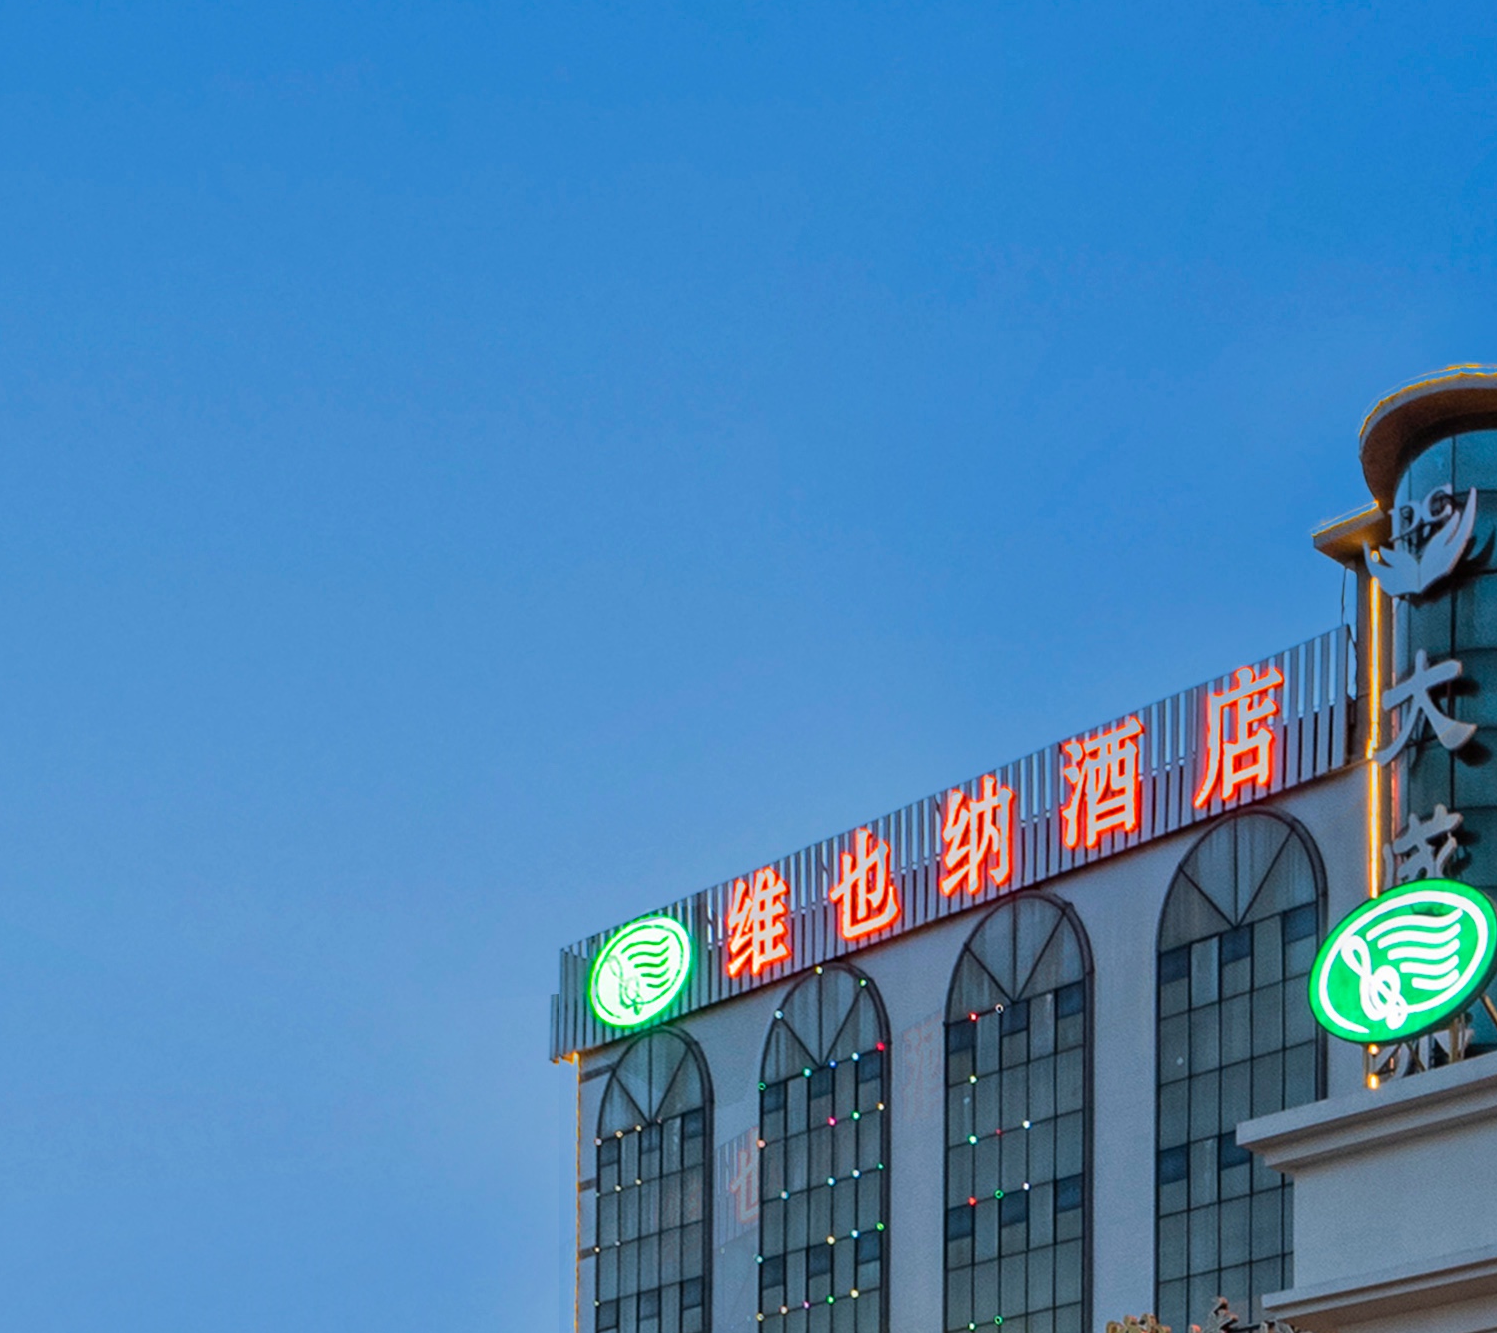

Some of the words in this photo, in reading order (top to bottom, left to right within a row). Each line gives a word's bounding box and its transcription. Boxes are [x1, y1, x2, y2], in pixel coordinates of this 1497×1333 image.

[724, 665, 1284, 979] 维也纳酒店
